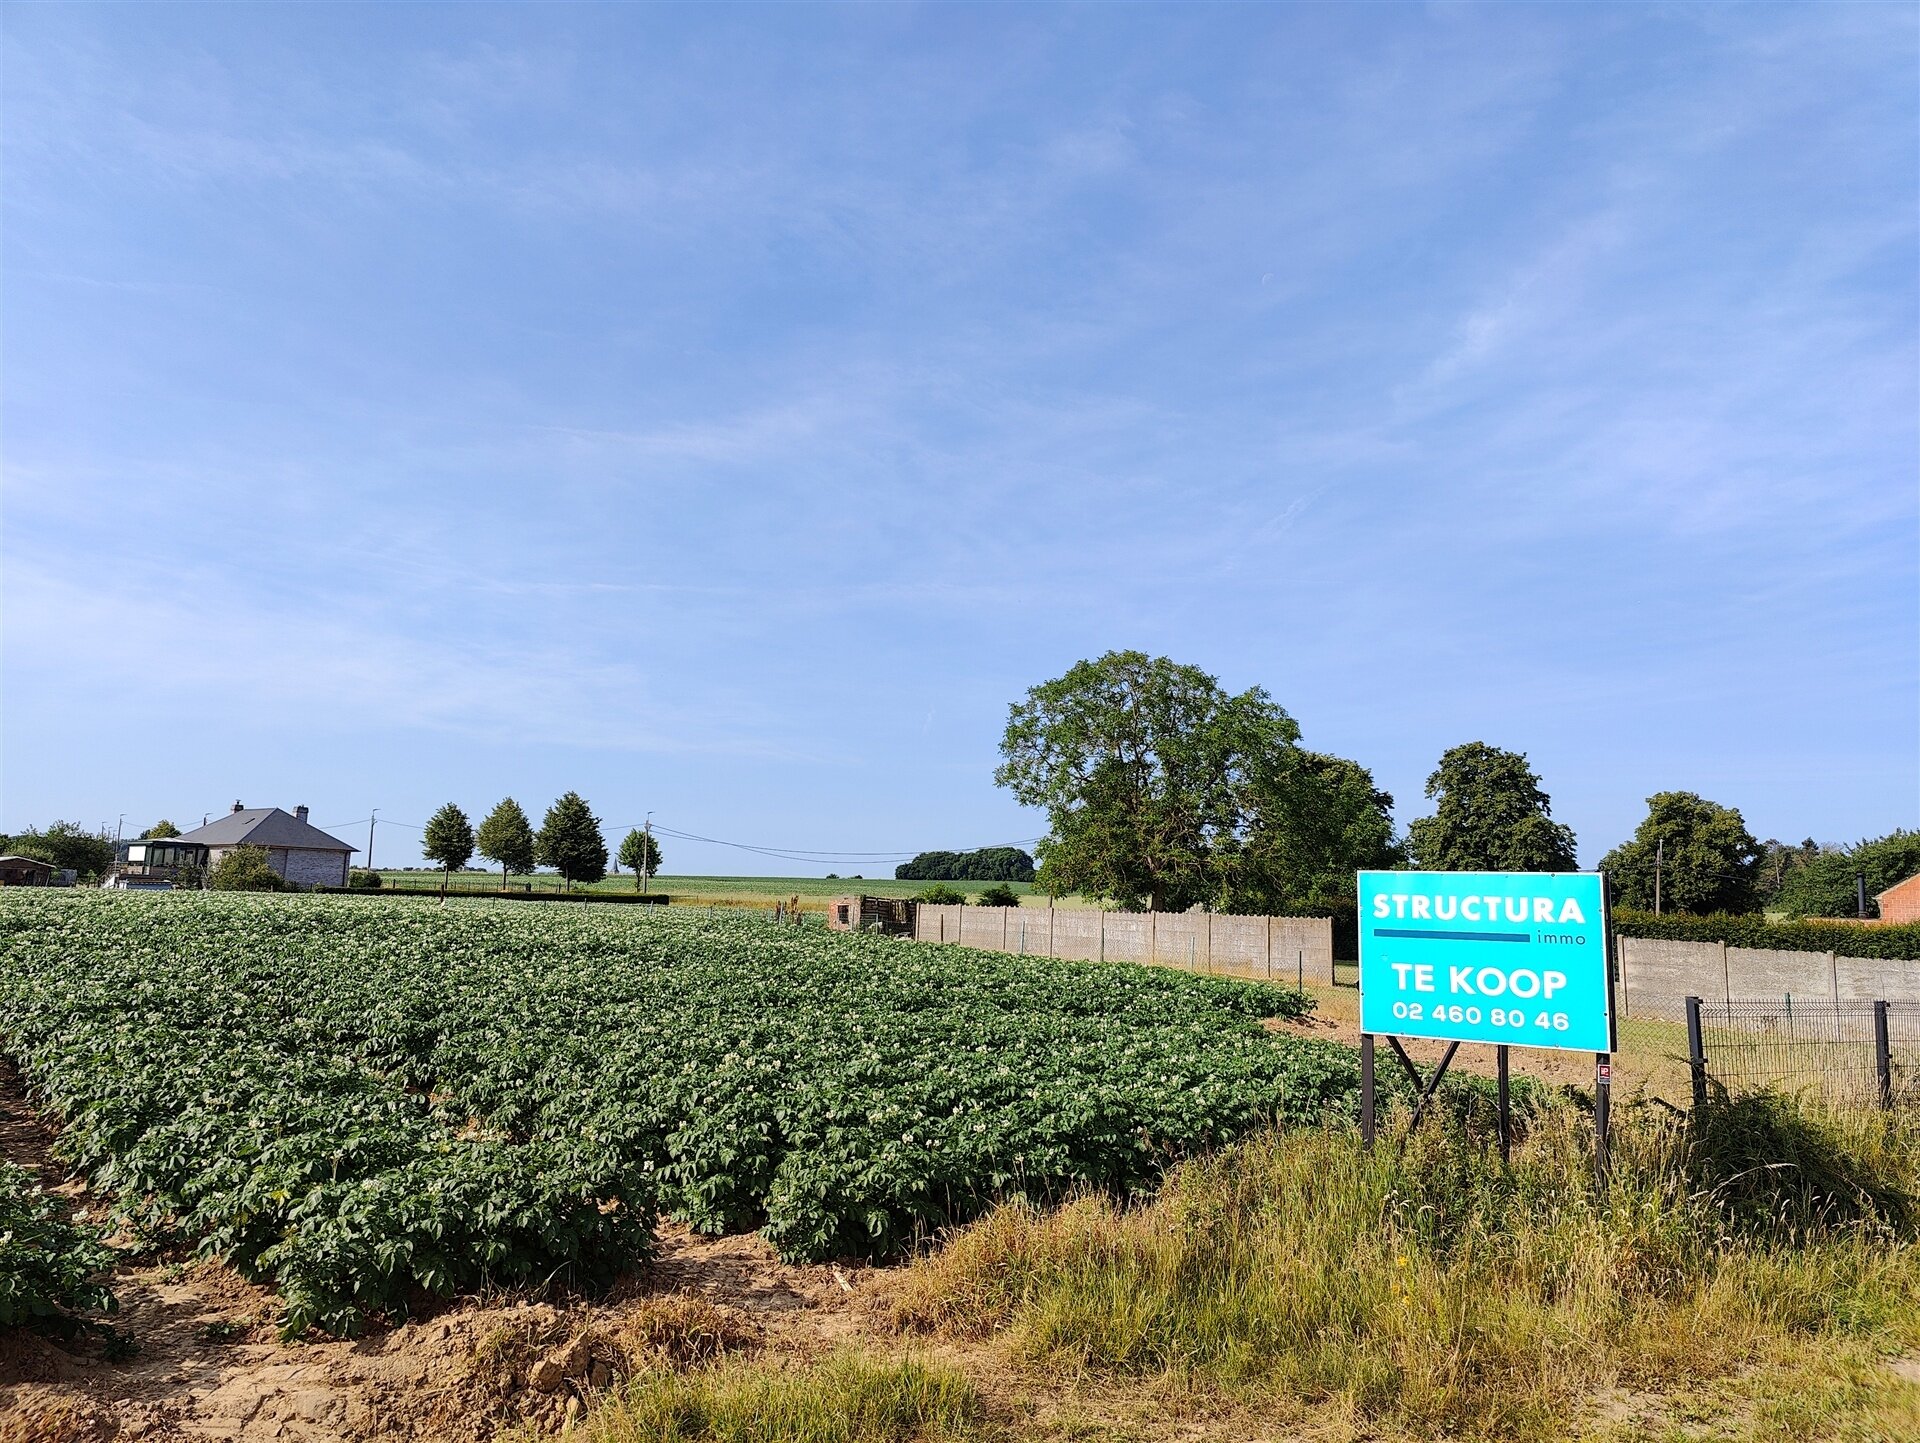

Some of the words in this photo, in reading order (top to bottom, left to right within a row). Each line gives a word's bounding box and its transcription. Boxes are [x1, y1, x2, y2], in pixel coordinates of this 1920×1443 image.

[1373, 893, 1585, 924] STRUCTURA
[1537, 929, 1586, 946] immo
[1391, 963, 1435, 992] TE
[1449, 965, 1567, 999] KOOP
[1392, 1001, 1423, 1021] 02
[1431, 1004, 1482, 1025] 460
[1490, 1009, 1525, 1028] 80
[1534, 1012, 1569, 1031] 46
